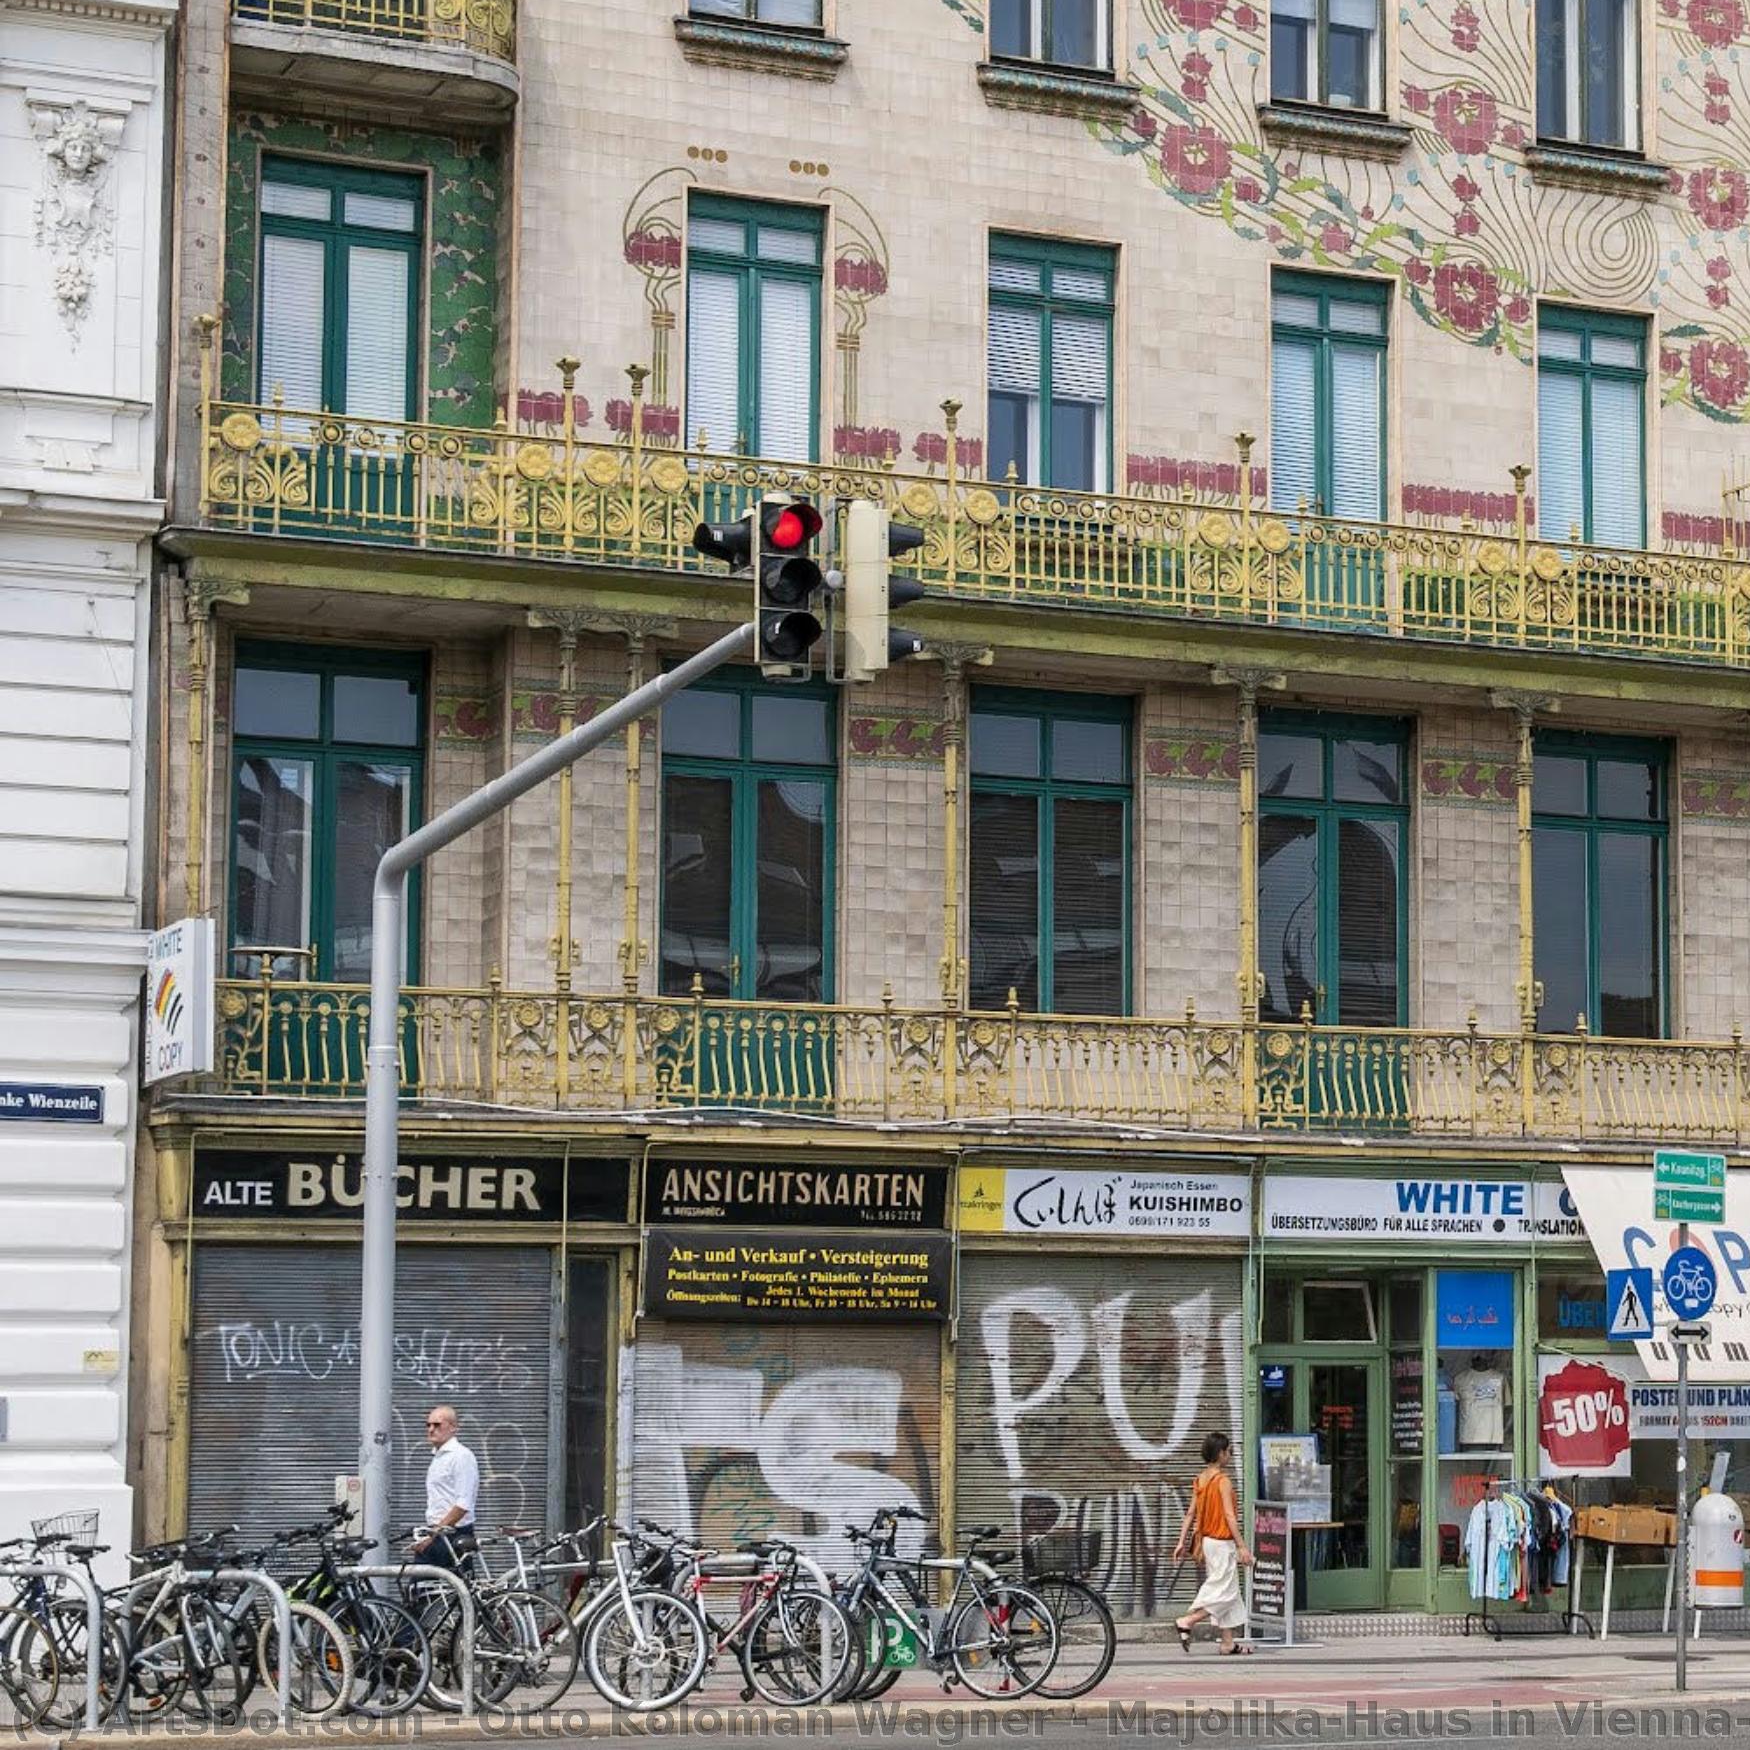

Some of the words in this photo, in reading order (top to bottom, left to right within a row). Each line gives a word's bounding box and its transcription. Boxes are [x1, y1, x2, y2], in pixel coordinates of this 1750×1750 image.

[29, 1094, 98, 1111] Wienzeile
[203, 1181, 274, 1206] ALTE
[287, 1155, 541, 1210] BÜCHER
[661, 1168, 925, 1207] ANSICHTSKARTEN
[1130, 1179, 1184, 1192] Japanisch
[1186, 1181, 1218, 1190] Essen
[1129, 1195, 1243, 1212] KUISHIMBO
[1396, 1182, 1524, 1216] WHITE
[1271, 1213, 1378, 1231] ÜBERSETZUNGSBÜRO
[1383, 1215, 1402, 1231] FÜR
[1405, 1218, 1429, 1232] ALLE
[1431, 1220, 1483, 1234] SPRACHEN
[668, 1247, 700, 1262] An-
[704, 1249, 735, 1262] und
[742, 1249, 806, 1264] Verkauf
[820, 1250, 929, 1269] Versteigerung
[667, 1268, 729, 1282] Postkarten
[740, 1270, 799, 1284] Fotografie
[809, 1272, 861, 1284] Philatelie
[808, 1286, 868, 1298] Wochenende
[1686, 1389, 1715, 1407] UND
[1543, 1389, 1625, 1438] -50%
